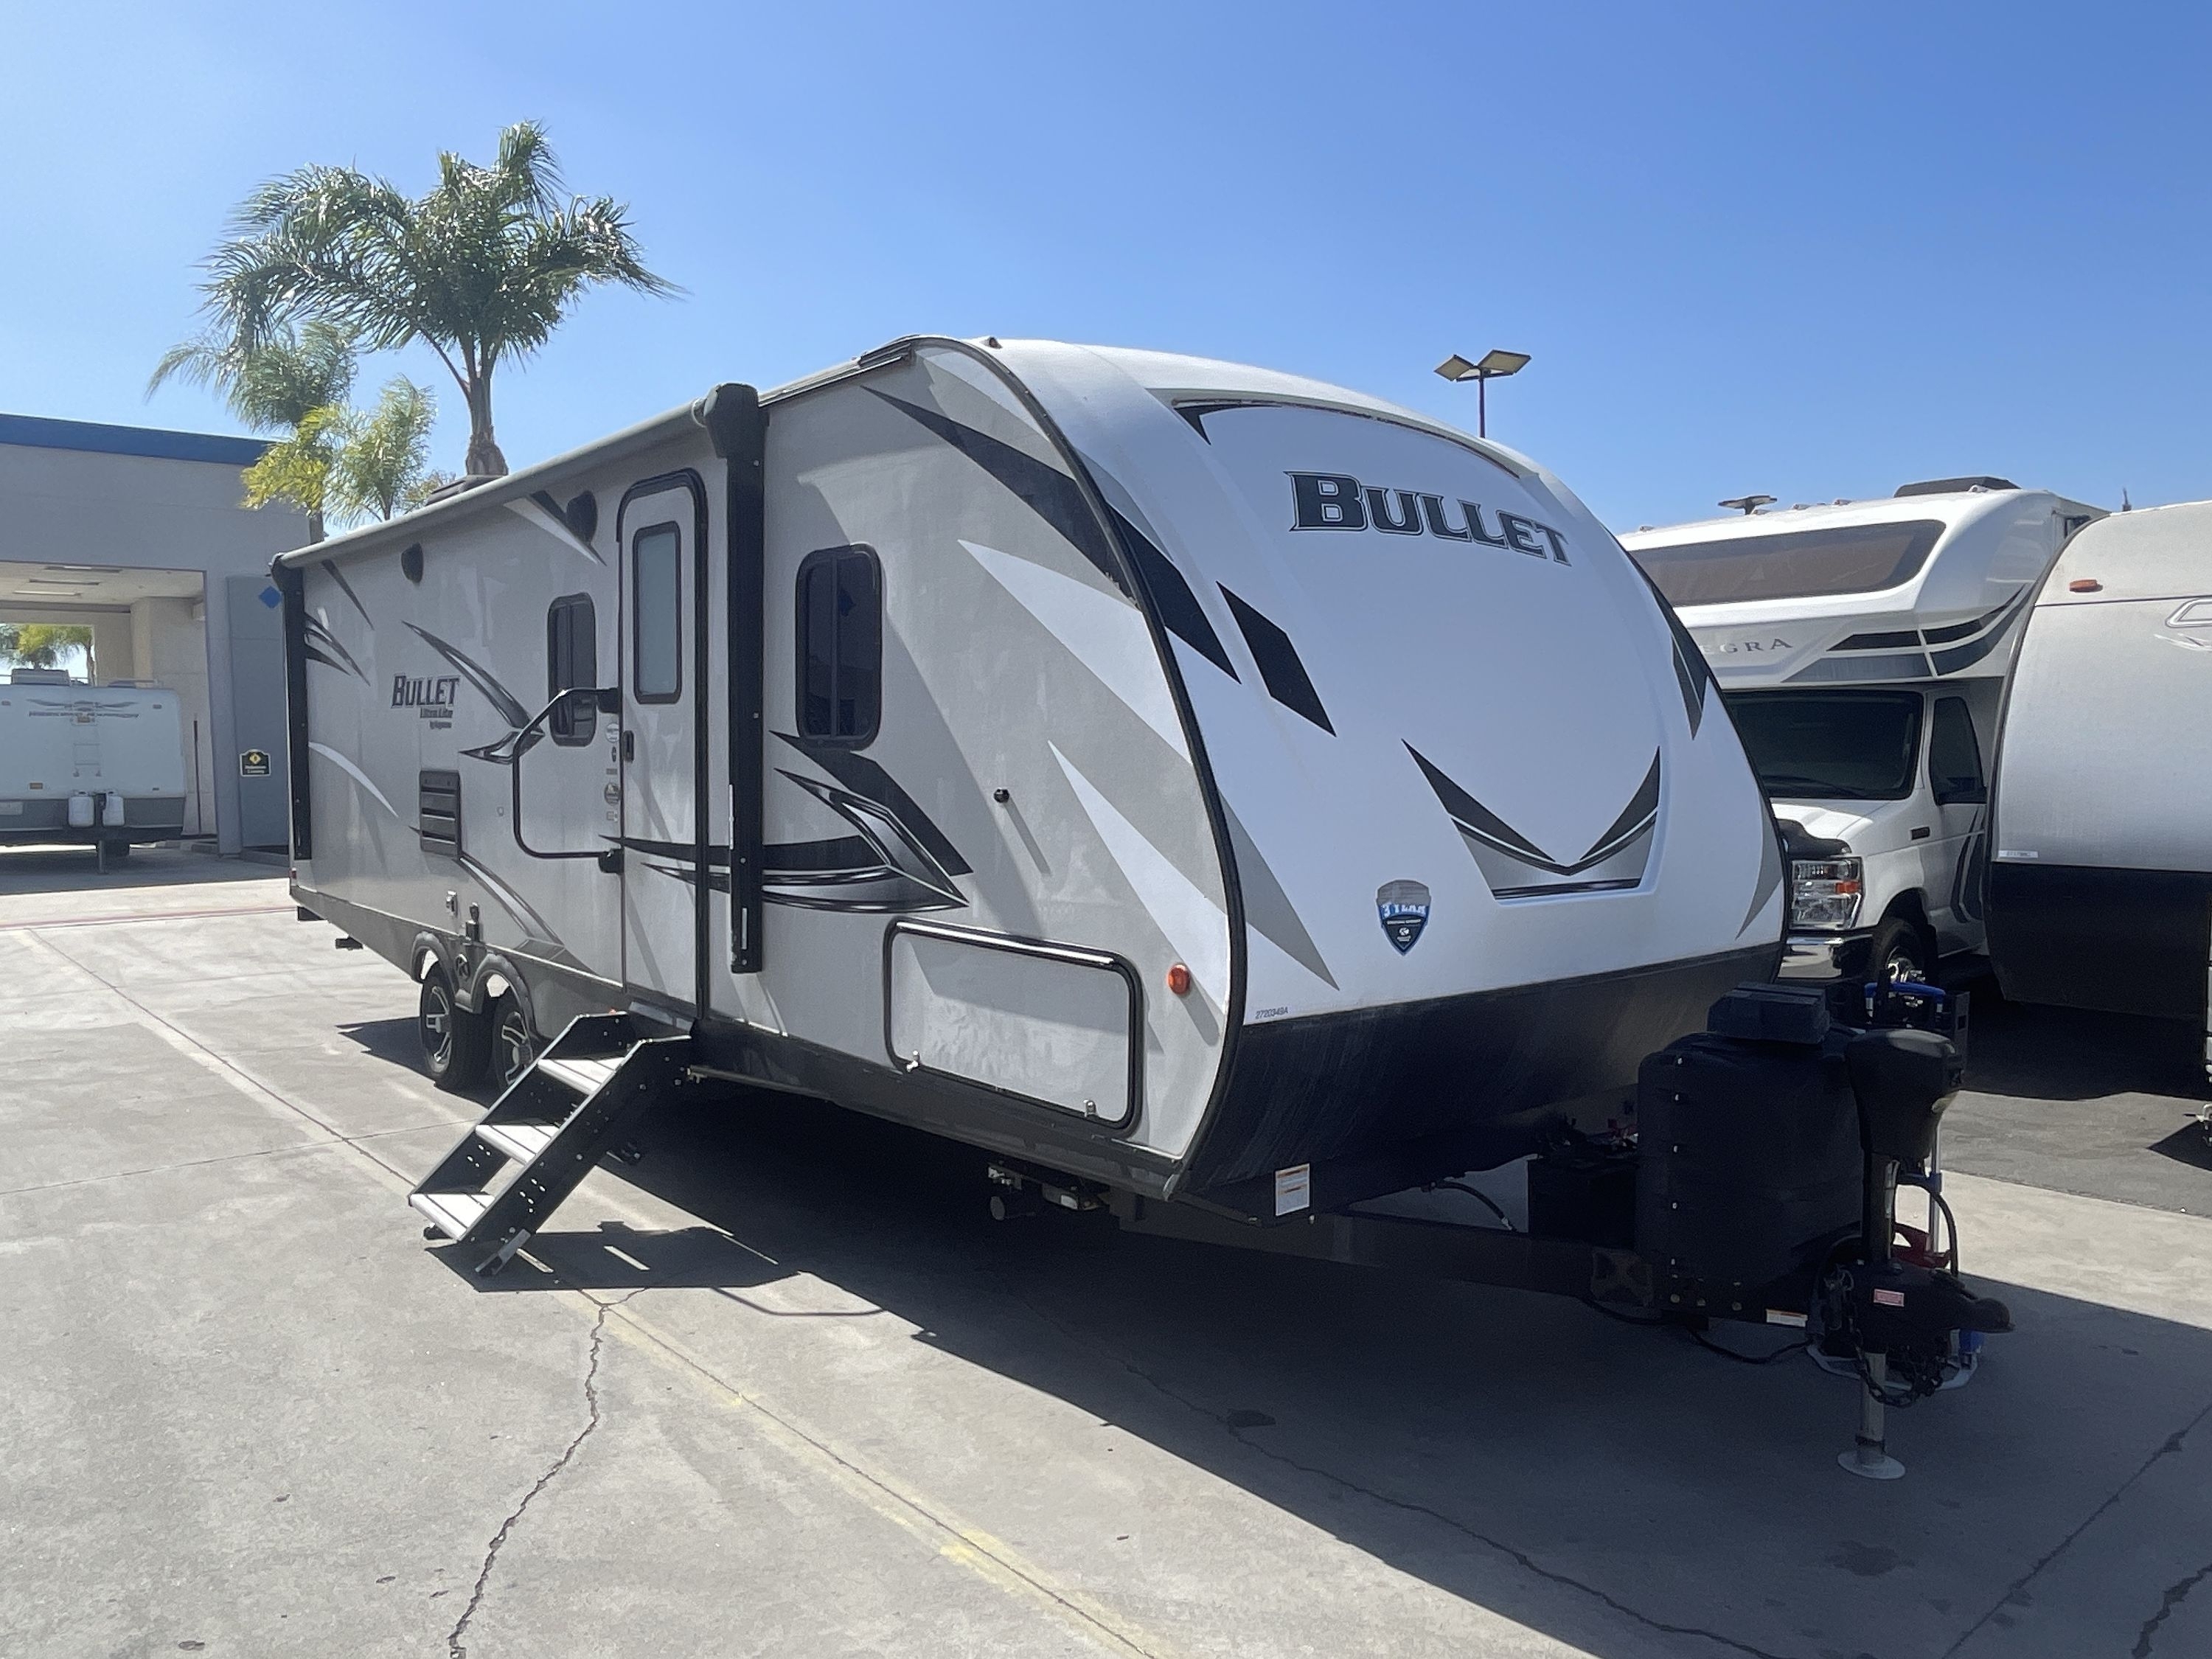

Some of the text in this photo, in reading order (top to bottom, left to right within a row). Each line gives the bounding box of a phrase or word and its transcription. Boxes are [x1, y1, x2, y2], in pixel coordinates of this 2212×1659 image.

[1283, 470, 1572, 567] BULLET
[1698, 639, 1793, 654] EGRA
[390, 672, 461, 709] BULLET
